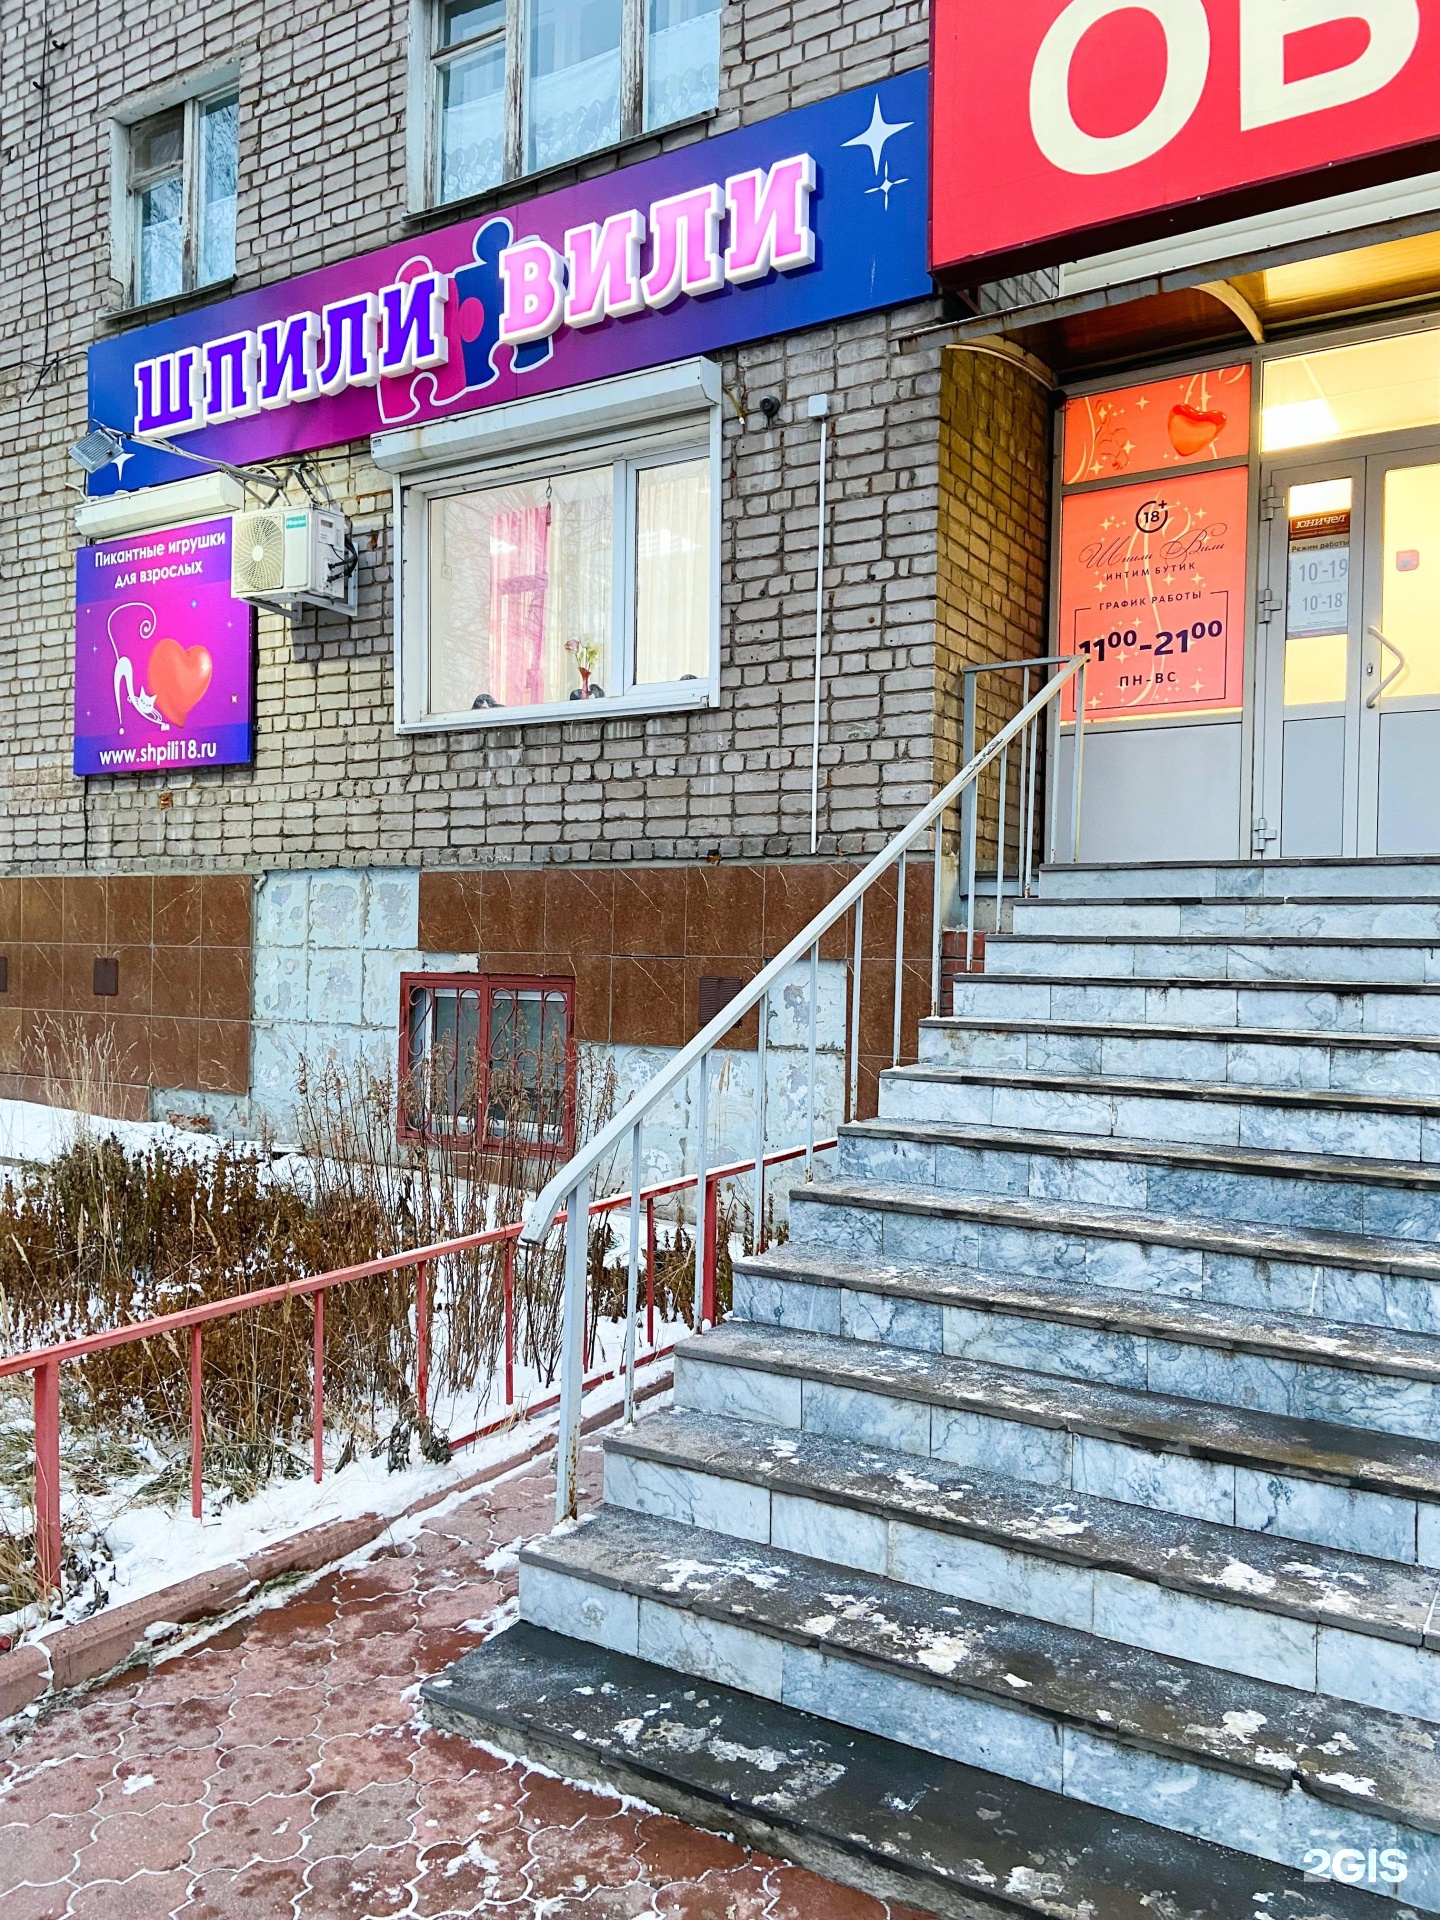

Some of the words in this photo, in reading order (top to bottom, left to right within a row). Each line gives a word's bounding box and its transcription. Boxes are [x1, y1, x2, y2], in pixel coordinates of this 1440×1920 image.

[134, 272, 449, 436] ШПИЛИ
[499, 152, 817, 346] ВИЛИ
[94, 543, 165, 568] Пикантные
[168, 531, 226, 556] игрушки
[1291, 544, 1319, 553] Режим
[114, 572, 137, 590] для
[139, 560, 203, 585] взрослых
[1106, 568, 1150, 581] ИНТИМ
[1155, 562, 1196, 575] БУТИК
[1099, 597, 1147, 611] ГРАФИК
[1152, 590, 1202, 604] РАБОТЫ
[1119, 671, 1177, 687] ПН-ВС
[99, 739, 217, 766] www.shpili18.ru
